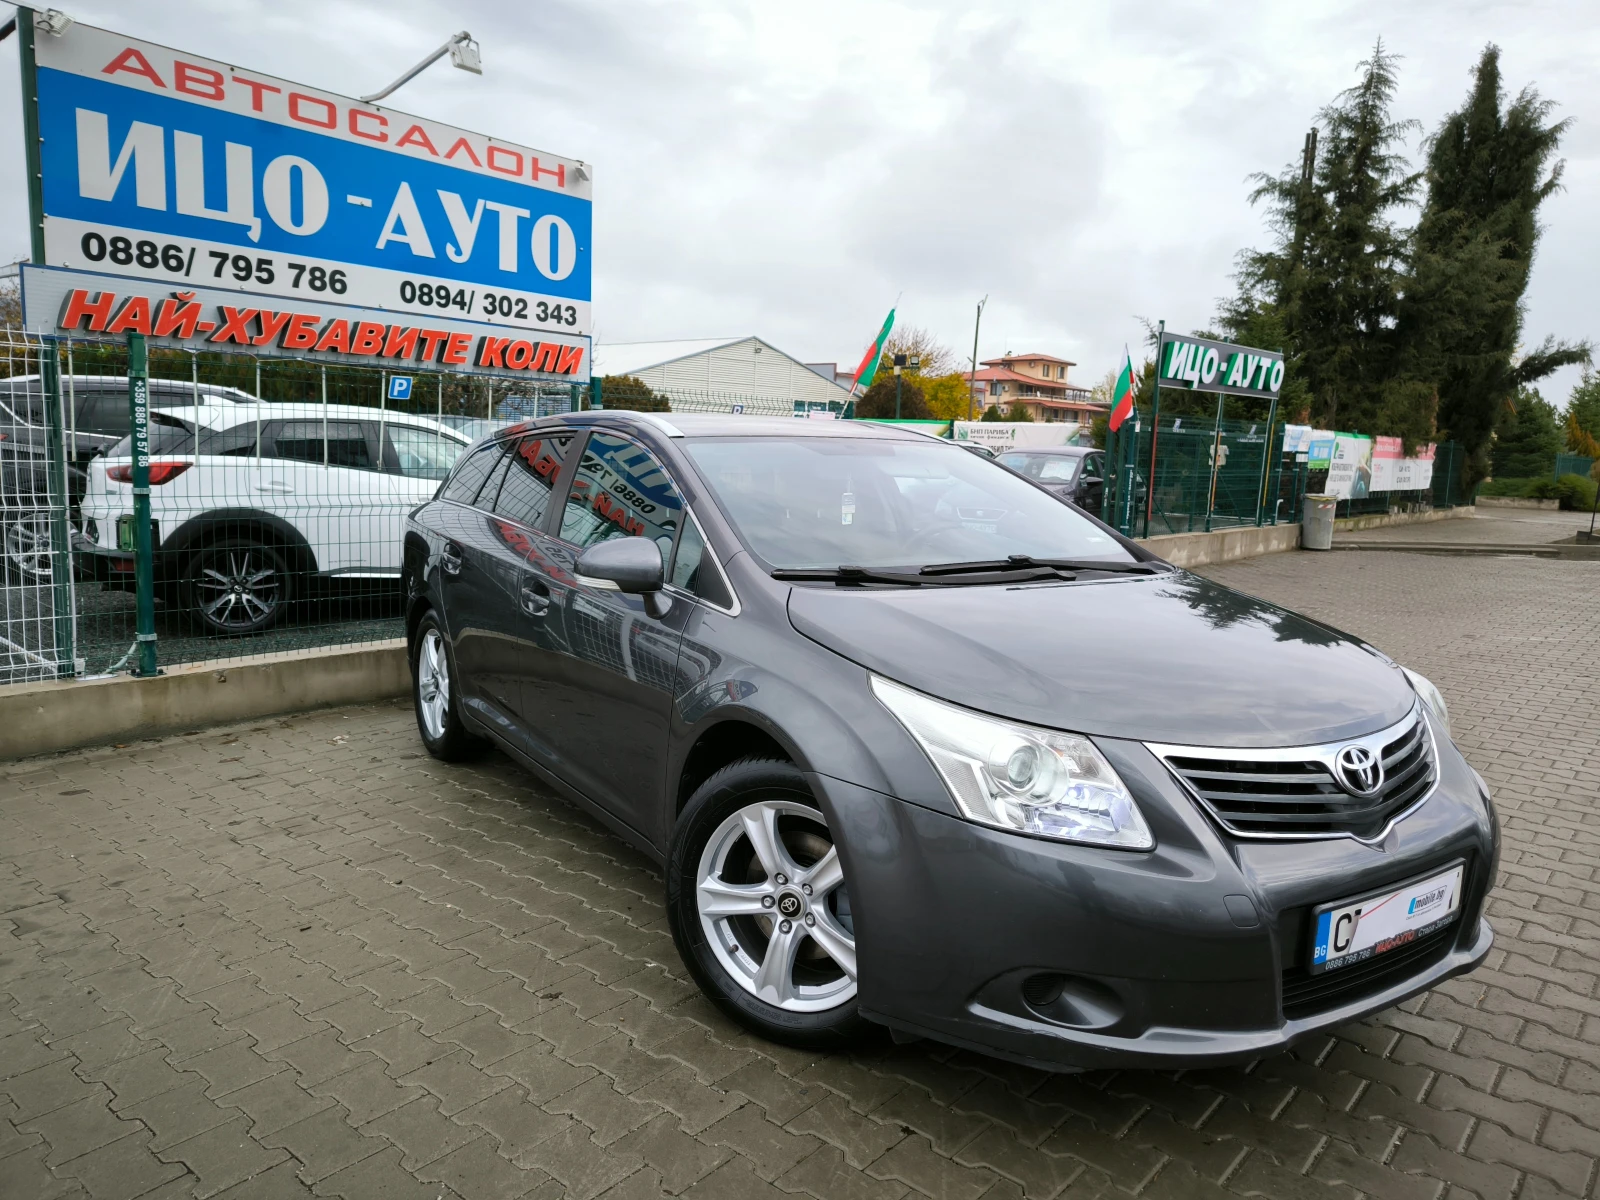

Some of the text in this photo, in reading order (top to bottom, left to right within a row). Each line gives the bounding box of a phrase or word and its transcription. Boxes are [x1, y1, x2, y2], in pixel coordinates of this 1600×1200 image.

[101, 47, 566, 189] АВТОСАЛОН
[81, 231, 348, 296] 0886/ 795 786
[61, 289, 584, 375] НАЙ-ХУБАВИТЕ КОЛИ
[399, 280, 578, 327] 0894/ 302 343
[134, 380, 149, 468] +359 886 79 57 86
[1314, 945, 1327, 959] BG
[1325, 958, 1344, 970] 0886
[1344, 953, 1358, 965] 795
